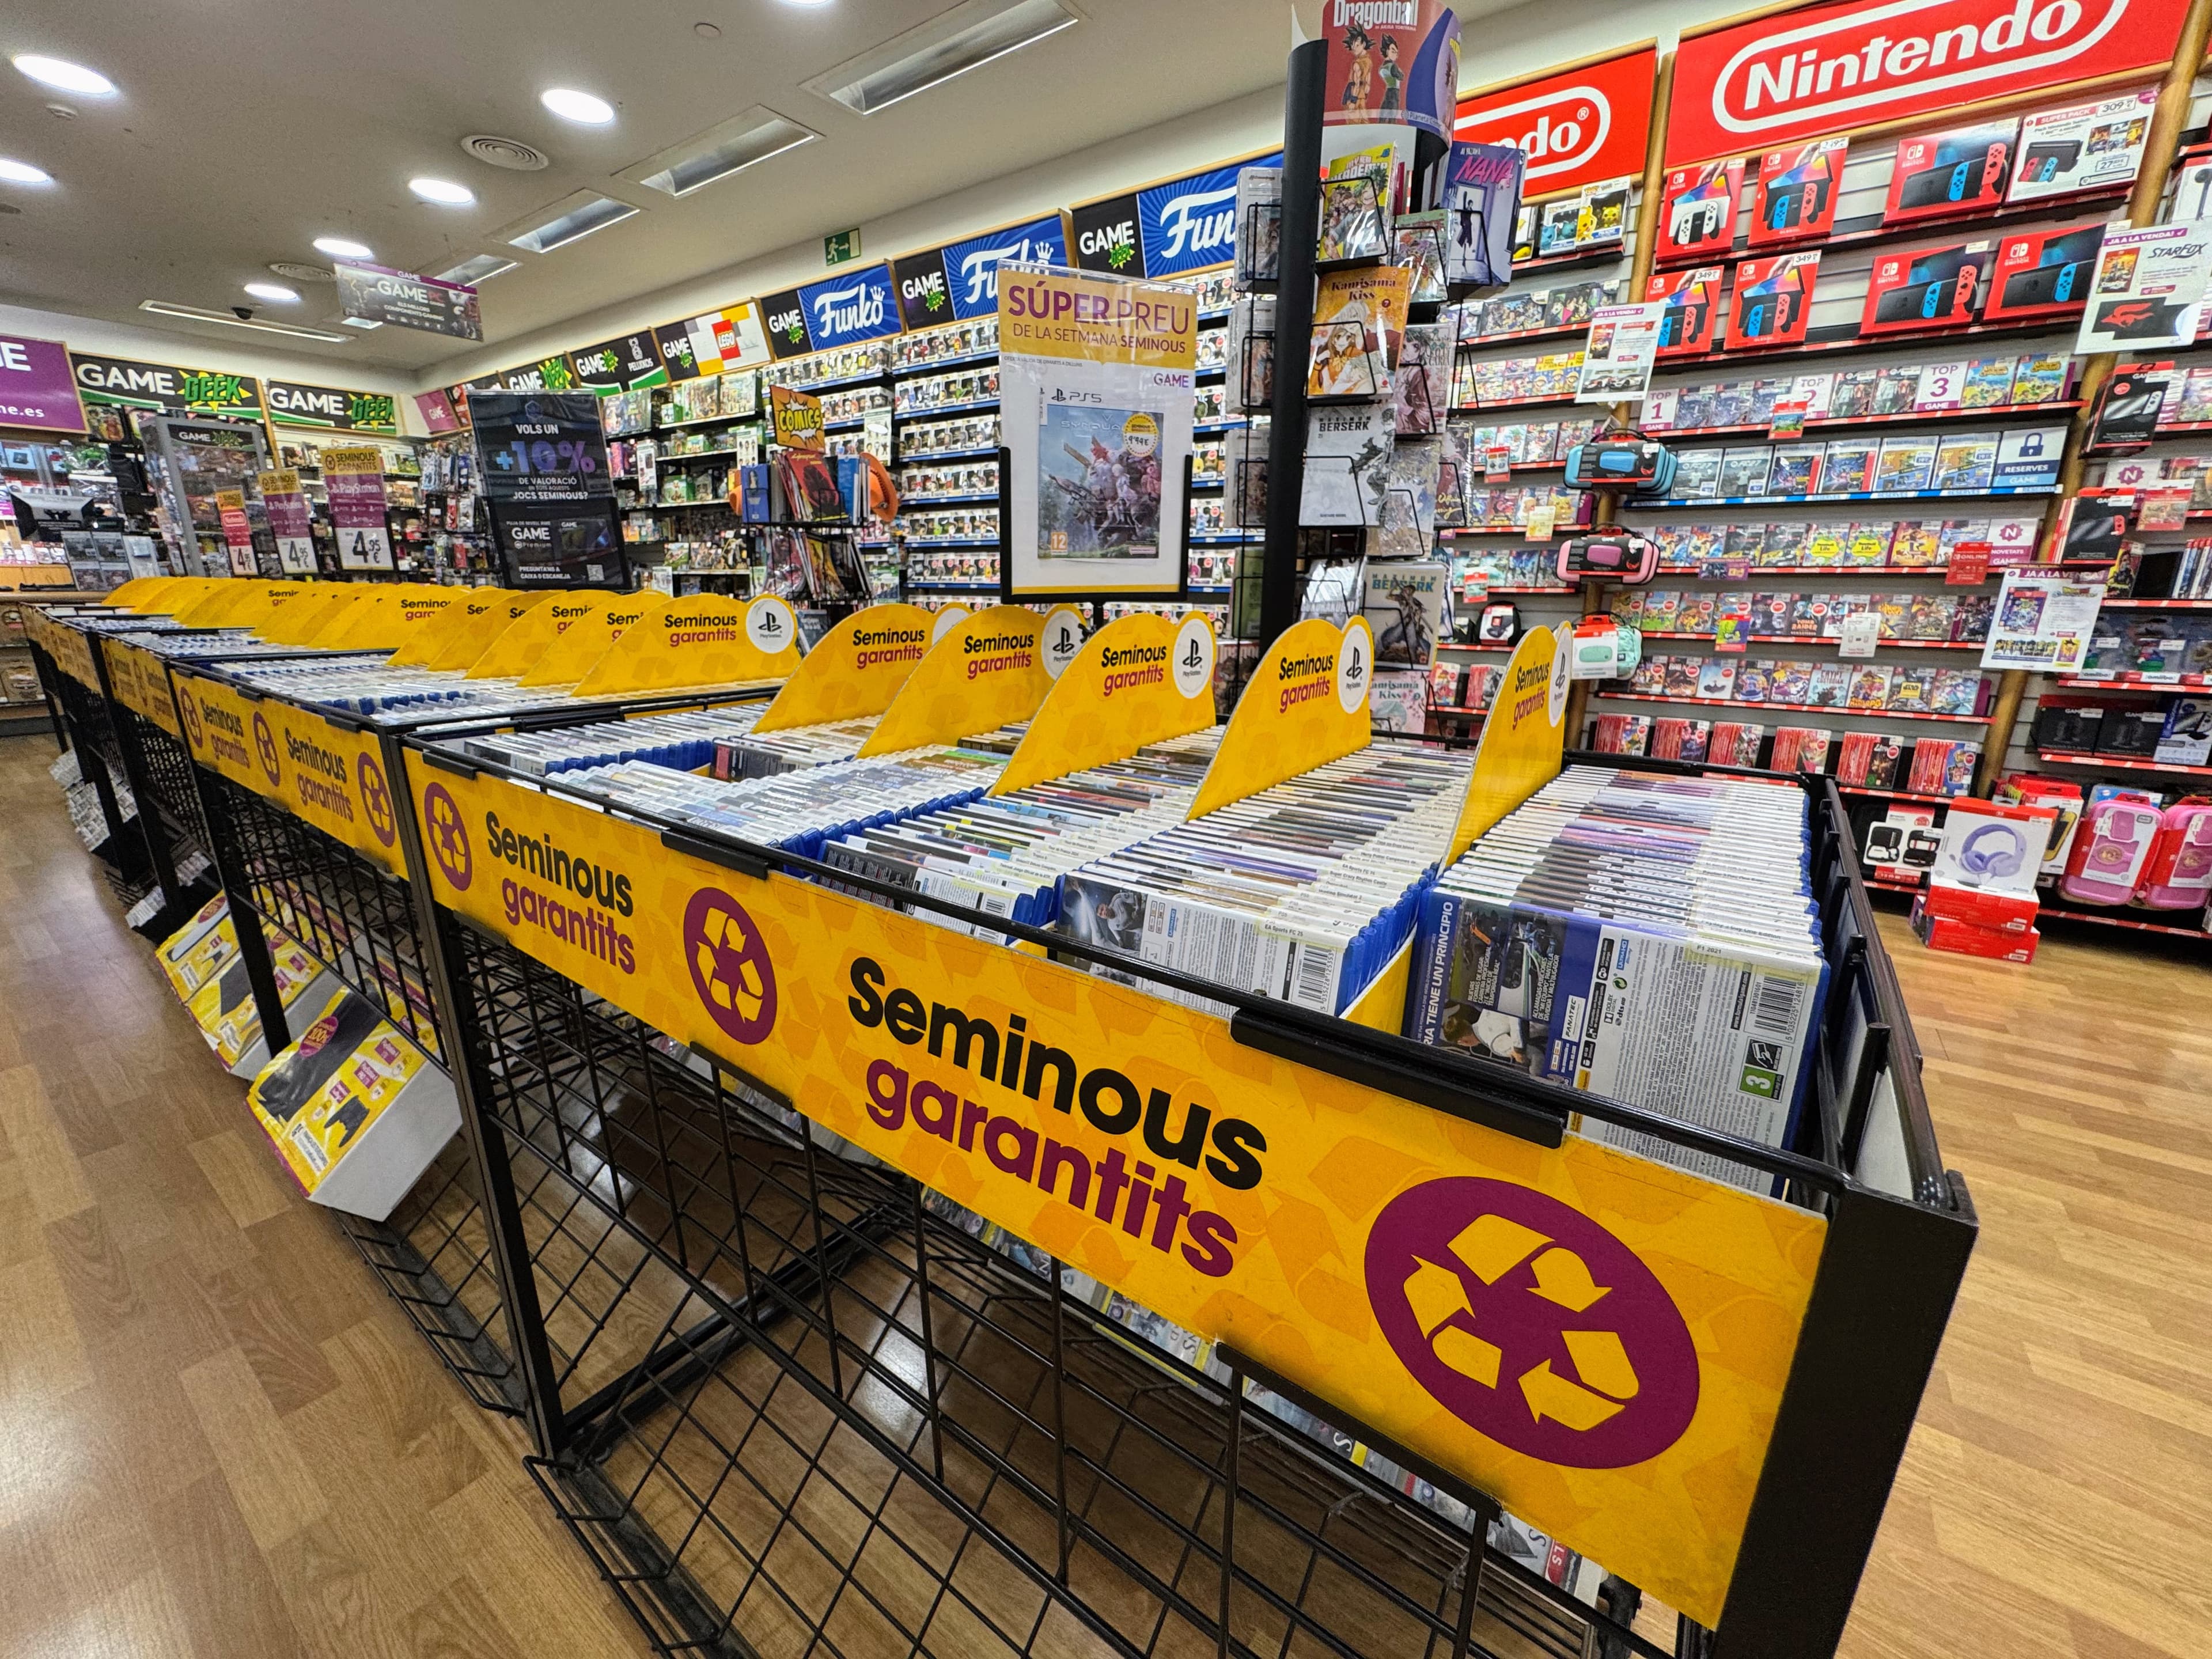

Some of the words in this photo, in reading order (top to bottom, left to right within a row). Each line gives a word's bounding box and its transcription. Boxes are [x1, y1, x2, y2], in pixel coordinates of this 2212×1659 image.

[1334, 0, 1419, 30] Dragonball
[1744, 0, 2085, 111] Nintendo
[2040, 113, 2068, 124] SUPER
[2069, 108, 2091, 119] PACK
[1455, 156, 1515, 187] NANA
[1160, 185, 1236, 258] Fun
[1080, 220, 1135, 256] GAME
[2128, 234, 2141, 242] LA
[2141, 231, 2175, 241] VENDA!
[1795, 254, 1812, 263] 349
[397, 271, 422, 282] GAME
[902, 271, 945, 300] GAME
[1331, 278, 1396, 291] Kamisama
[1697, 271, 1712, 279] 349
[377, 281, 429, 303] GAME
[1349, 290, 1375, 301] Kiss
[814, 283, 885, 338] Funko
[1008, 281, 1112, 327] SÚPER
[1118, 300, 1189, 335] PREU
[768, 309, 804, 334] GAME
[662, 338, 689, 358] GAME
[718, 332, 735, 347] LEGO
[1013, 323, 1032, 338] DE
[1035, 325, 1051, 340] LA
[1054, 327, 1119, 347] SETMANA
[1121, 335, 1186, 354] SEMINOUS
[576, 353, 605, 377] GAME
[1931, 365, 1959, 376] TOP
[77, 363, 175, 395] GAME
[184, 376, 241, 402] GEEK
[509, 370, 543, 389] GAME
[1153, 373, 1189, 388] GAME
[1801, 378, 1825, 388] TOP
[1930, 377, 1949, 397] 3
[270, 388, 344, 416] GAME
[1070, 391, 1102, 403] PS5
[1650, 392, 1671, 400] TOP
[1925, 402, 1949, 410] GAME
[779, 408, 822, 431] COMICS
[1651, 402, 1663, 419] 1
[179, 431, 210, 441] GAME
[516, 424, 542, 434] VOLS
[544, 424, 559, 434] UN
[1319, 421, 1369, 432] BERSERK
[336, 452, 376, 462] SEMINOUS
[496, 440, 596, 473] +10%
[2005, 464, 2048, 473] RESERVES
[2009, 475, 2041, 484] GAME
[2123, 470, 2138, 480] N
[338, 484, 380, 495] PlayStation
[531, 476, 577, 485] VALORACIÓ
[513, 491, 537, 500] JOCS
[539, 491, 588, 500] SEMINOUS?
[512, 527, 550, 540] GAME
[1052, 534, 1066, 546] 12
[2005, 527, 2017, 537] N
[289, 540, 300, 568] 4
[352, 531, 369, 563] 4
[2047, 570, 2060, 578] LA
[1372, 579, 1434, 592] BERSERK
[664, 613, 737, 628] Seminous
[669, 627, 736, 647] garantits
[853, 627, 925, 646] Seminous
[964, 633, 1034, 654] Seminous
[857, 646, 923, 669] garantits
[967, 652, 1032, 680] garantits
[1101, 644, 1166, 668] Seminous
[1279, 654, 1333, 680] Seminous
[1103, 666, 1164, 697] garantits
[1515, 661, 1550, 692] Seminous
[1279, 677, 1330, 714] garantits
[1378, 691, 1402, 700] Kiss
[200, 698, 245, 737] Seminous
[1512, 686, 1546, 730] garantits
[210, 733, 251, 770] garantits
[284, 728, 348, 783] Seminous
[296, 771, 354, 823] garantits
[486, 811, 634, 916] Seminous
[1356, 876, 1372, 884] Rhythm
[502, 877, 636, 975] garantits
[1274, 925, 1288, 934] Sports
[1435, 901, 1453, 961] PRINCIPIO
[1707, 946, 1722, 955] 2021
[1432, 961, 1445, 983] UN
[1482, 946, 1492, 983] PROFESIONAL
[1545, 953, 1554, 981] PANTALLA
[1488, 974, 1497, 1006] TEMPORADA
[1532, 986, 1543, 1019] ACLAMADAS
[1538, 957, 1547, 985] FUNCIONES
[1543, 997, 1552, 1021] DIVIDIDA
[1548, 955, 1560, 993] MULTIJUGADOR
[1425, 984, 1442, 1027] TIENE
[1566, 997, 1577, 1038] FANATEC
[848, 956, 1268, 1191] Seminous
[1745, 1075, 1771, 1090] 3
[865, 1058, 1238, 1278] garantits
